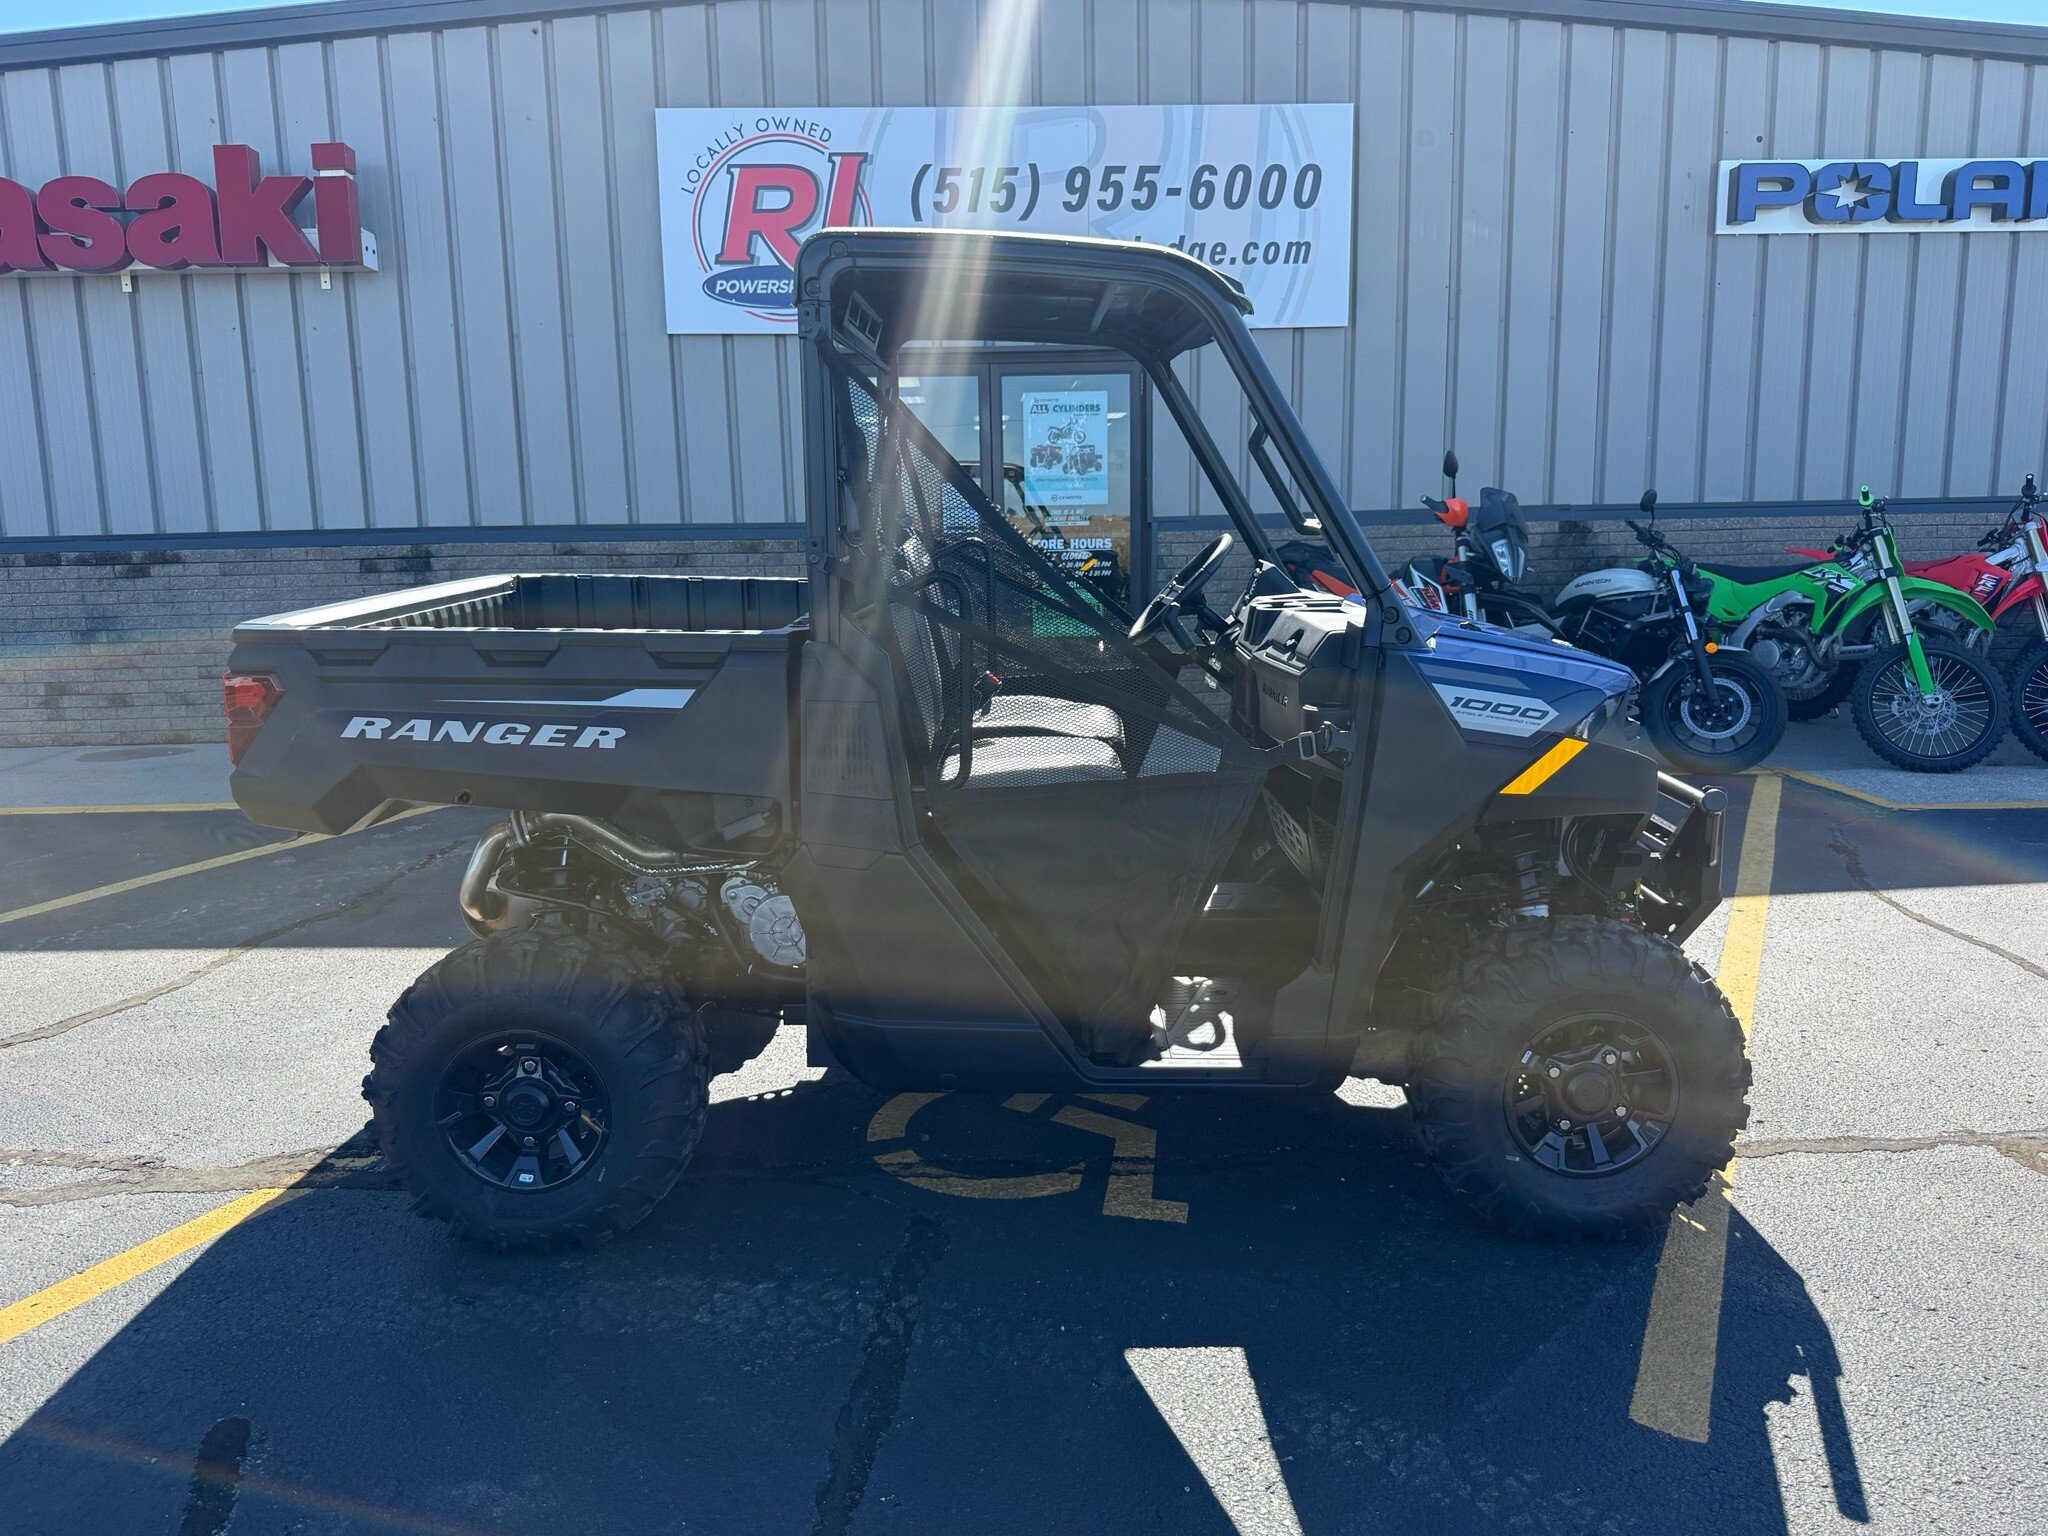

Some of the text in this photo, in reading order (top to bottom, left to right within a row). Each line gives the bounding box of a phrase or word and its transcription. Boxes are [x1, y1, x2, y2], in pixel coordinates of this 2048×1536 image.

[681, 116, 832, 194] LOCALLY OWNED
[911, 163, 1322, 222] (515) 955-6000
[1727, 160, 2048, 224] POLA
[1031, 403, 1101, 414] ALL CYLINDERS
[1070, 538, 1112, 549] HOURS
[1449, 696, 1550, 721] 1000
[1455, 709, 1484, 718] SINGLE
[1485, 714, 1524, 725] OVERHEAD
[340, 716, 627, 749] RANGER
